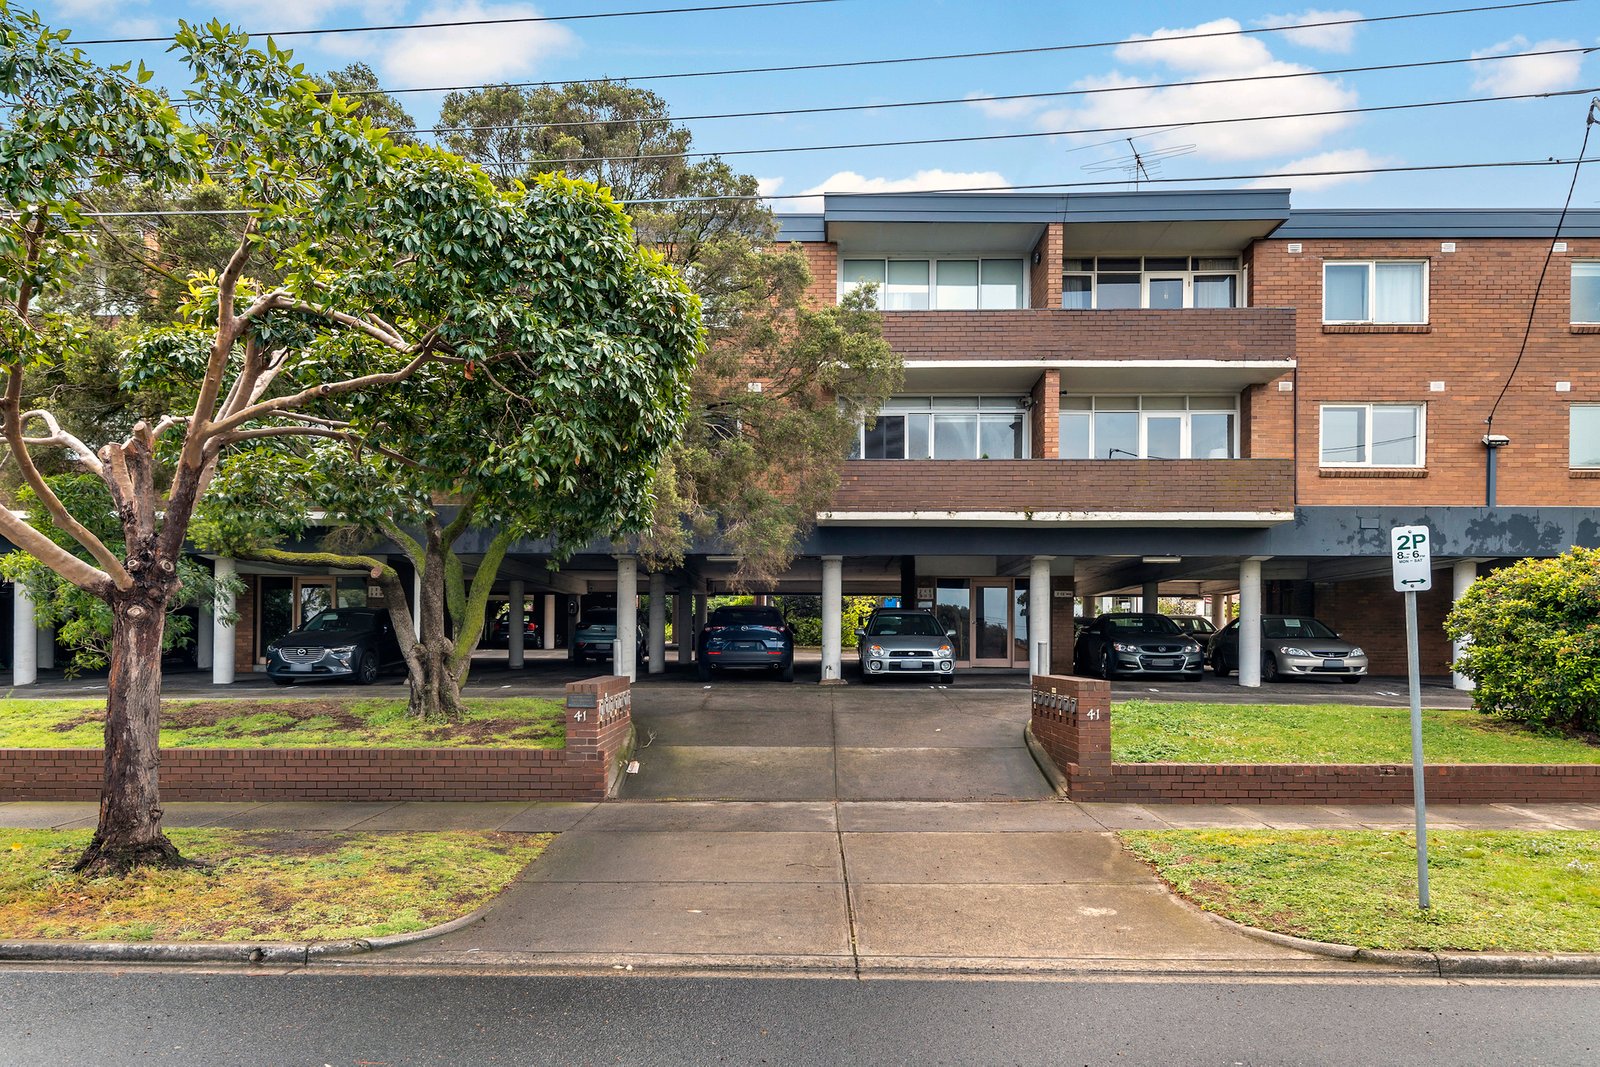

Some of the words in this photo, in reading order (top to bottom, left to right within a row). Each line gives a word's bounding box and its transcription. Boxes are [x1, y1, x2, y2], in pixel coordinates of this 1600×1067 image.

[1397, 534, 1426, 550] 2P
[574, 710, 587, 722] 41
[1086, 708, 1100, 720] 41
